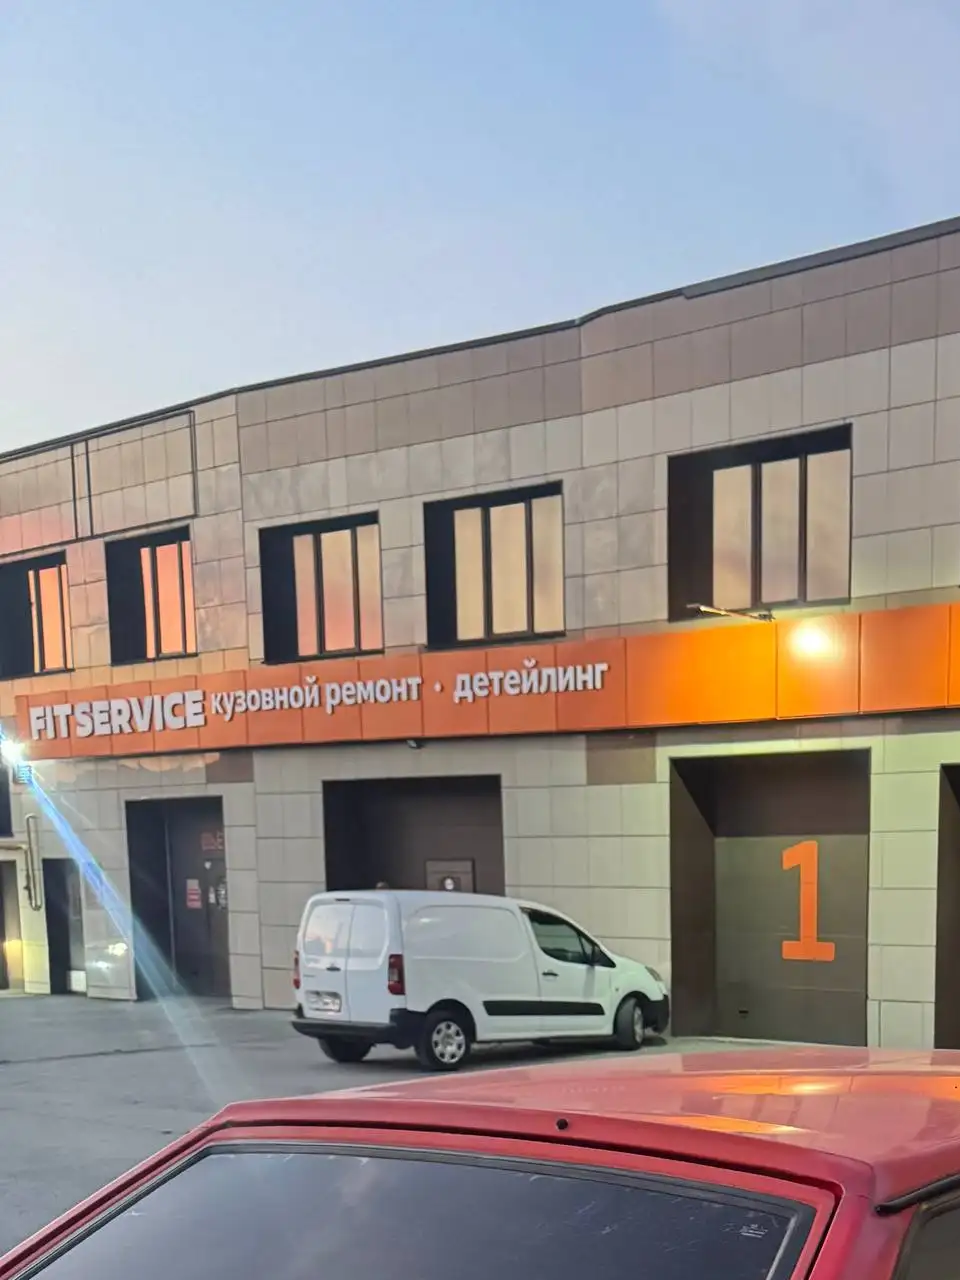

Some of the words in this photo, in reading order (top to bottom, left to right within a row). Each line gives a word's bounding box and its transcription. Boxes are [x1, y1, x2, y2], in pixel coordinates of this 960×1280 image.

[211, 676, 320, 721] кузовной
[324, 676, 422, 714] ремонт
[454, 658, 608, 703] детейлинг
[782, 840, 835, 961] 1
